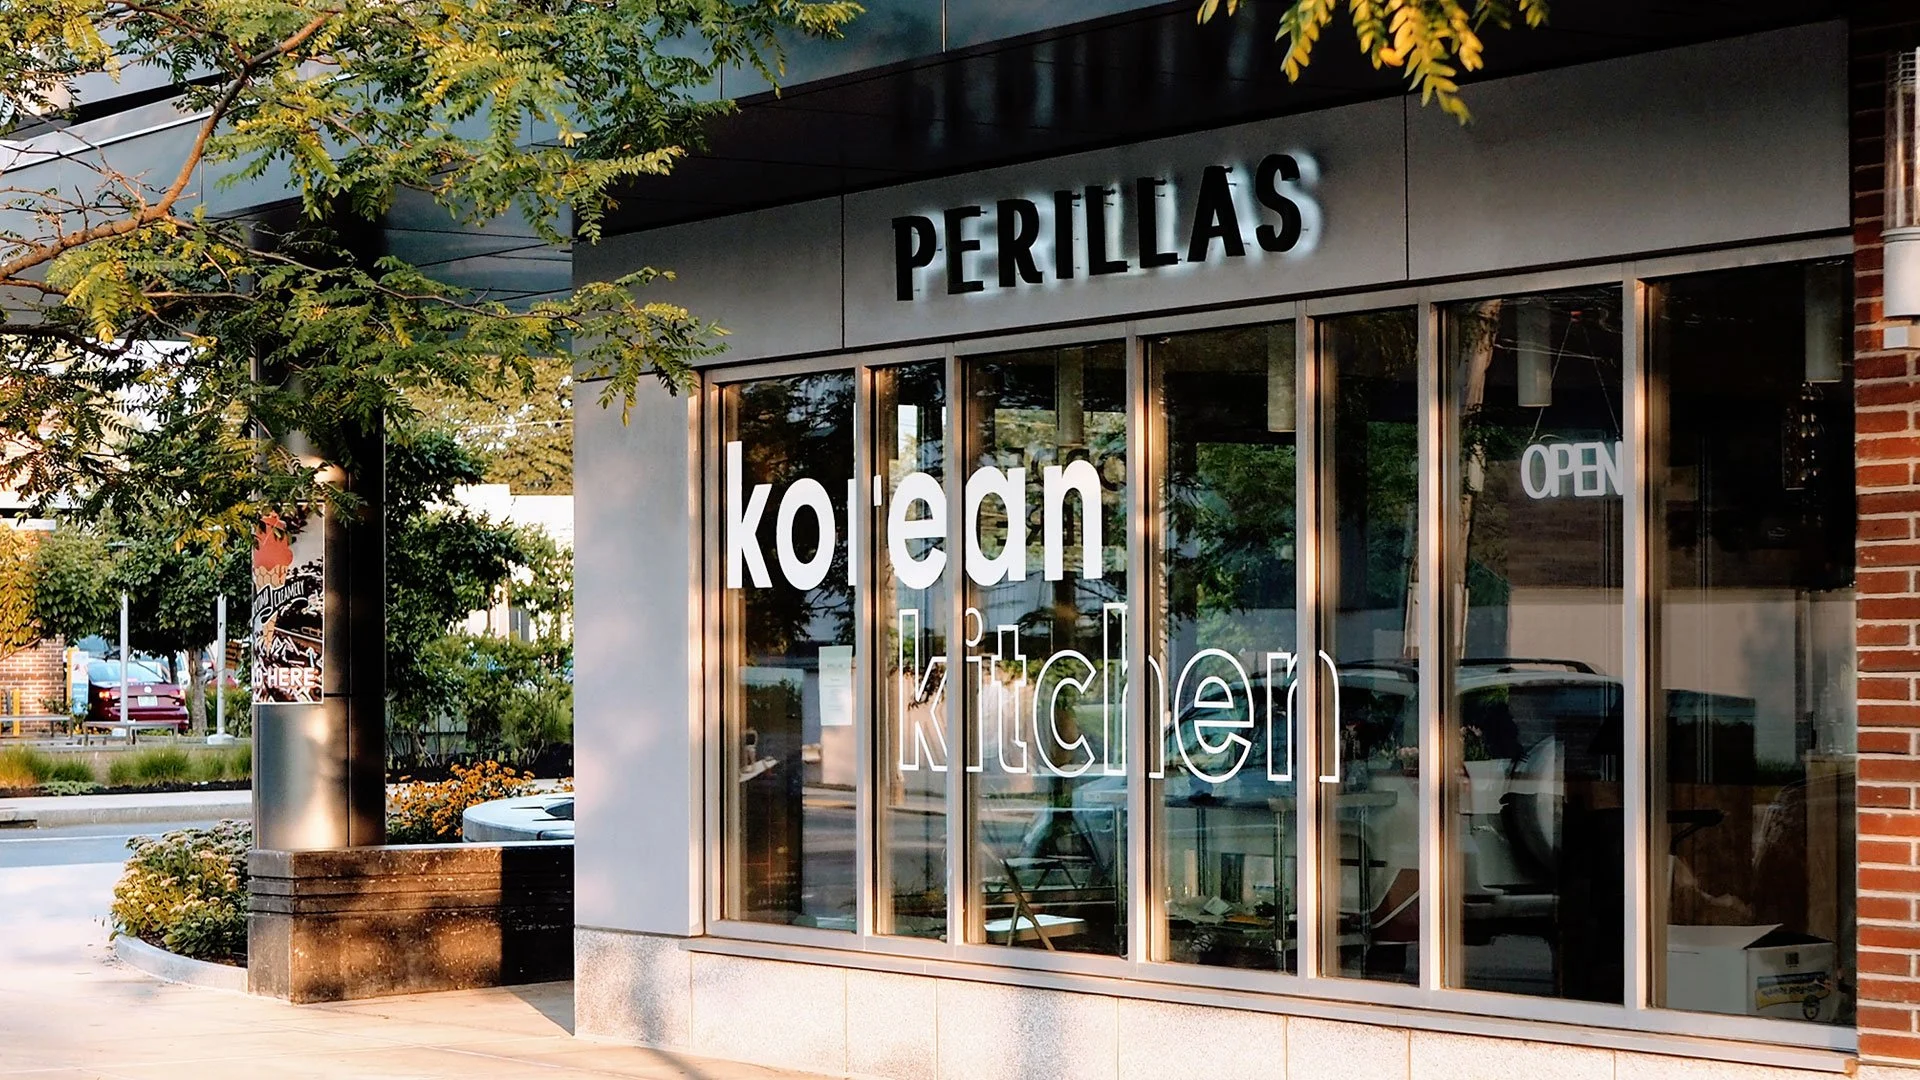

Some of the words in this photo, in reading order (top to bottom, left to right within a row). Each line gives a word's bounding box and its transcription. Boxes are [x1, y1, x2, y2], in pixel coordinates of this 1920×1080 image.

[892, 153, 1302, 301] PERILLAS
[1521, 441, 1624, 499] OPEN
[267, 666, 315, 688] HERE
[899, 602, 1340, 784] kitchen
